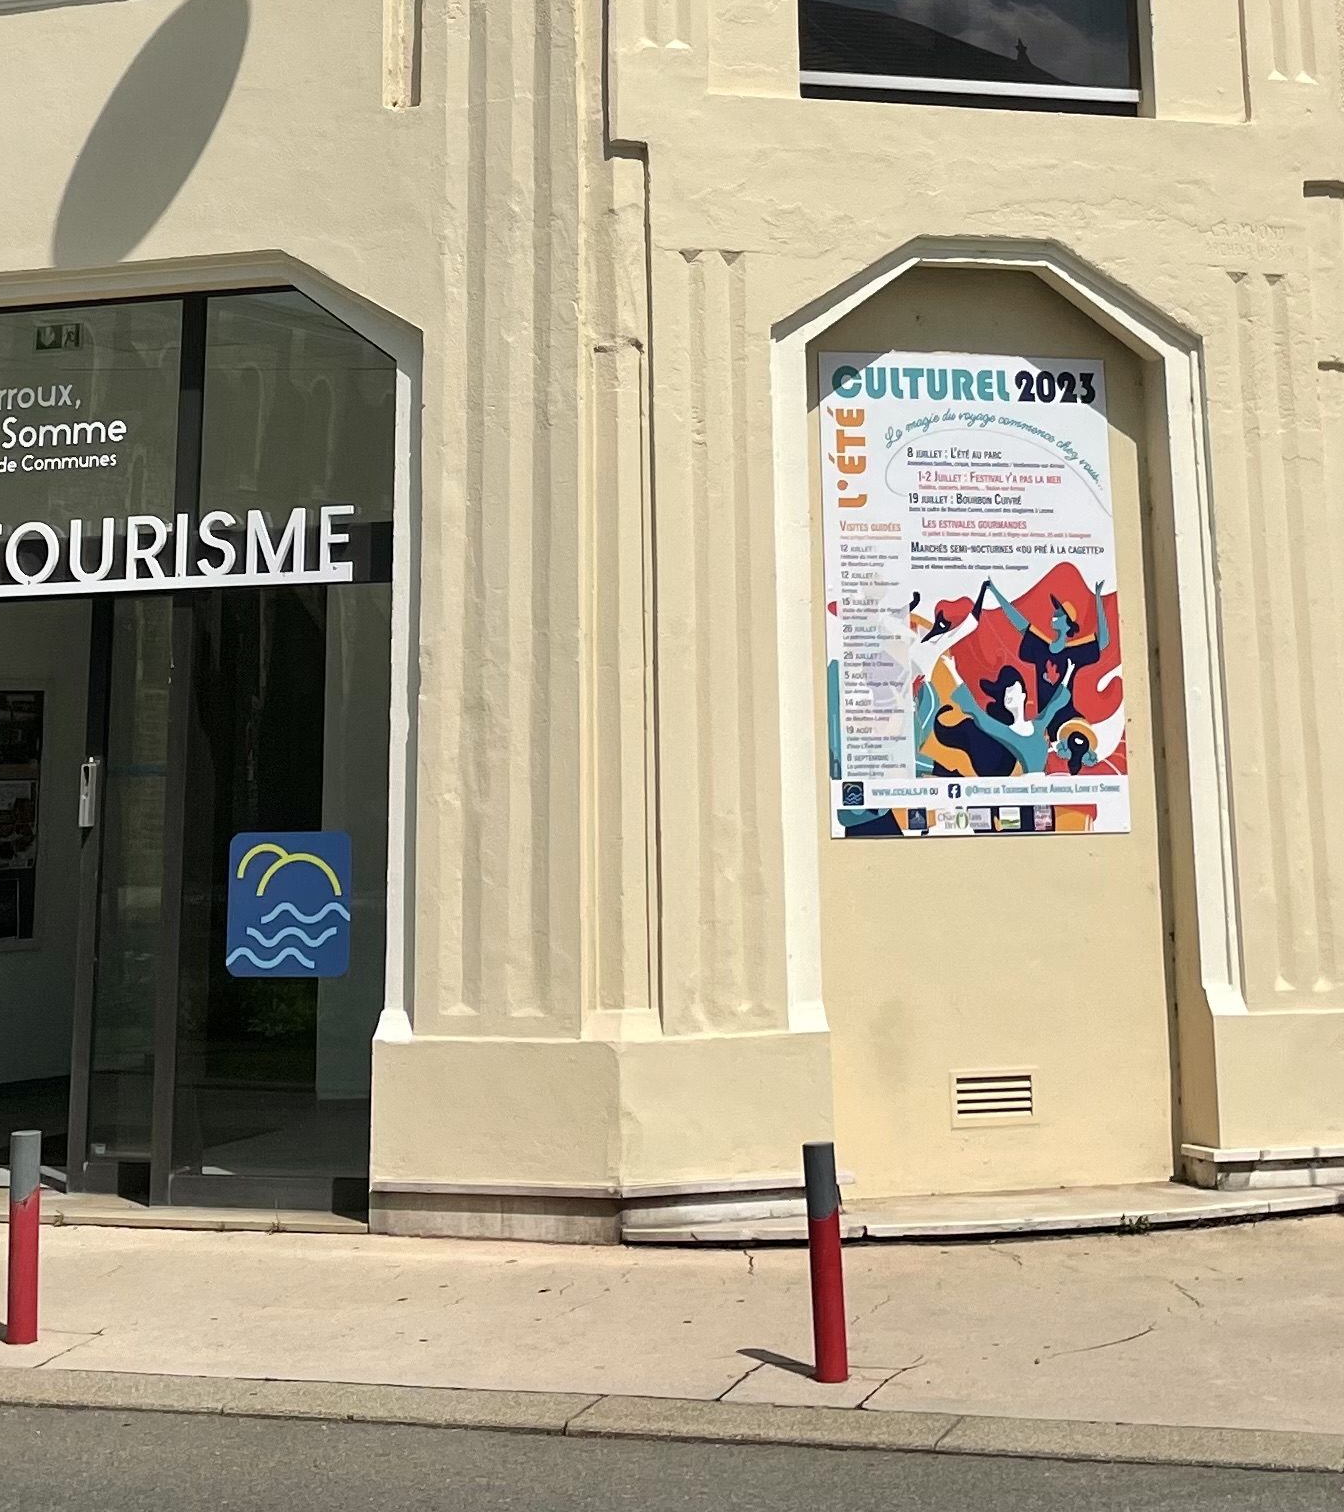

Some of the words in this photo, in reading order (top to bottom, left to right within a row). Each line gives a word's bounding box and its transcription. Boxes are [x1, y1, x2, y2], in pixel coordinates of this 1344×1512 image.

[832, 365, 1010, 402] CULTUREL
[1014, 370, 1096, 404] 2023
[2, 416, 127, 449] Somme
[958, 411, 996, 428] voyage
[998, 416, 1055, 443] commence
[21, 453, 117, 472] Communes
[909, 493, 919, 504] 19
